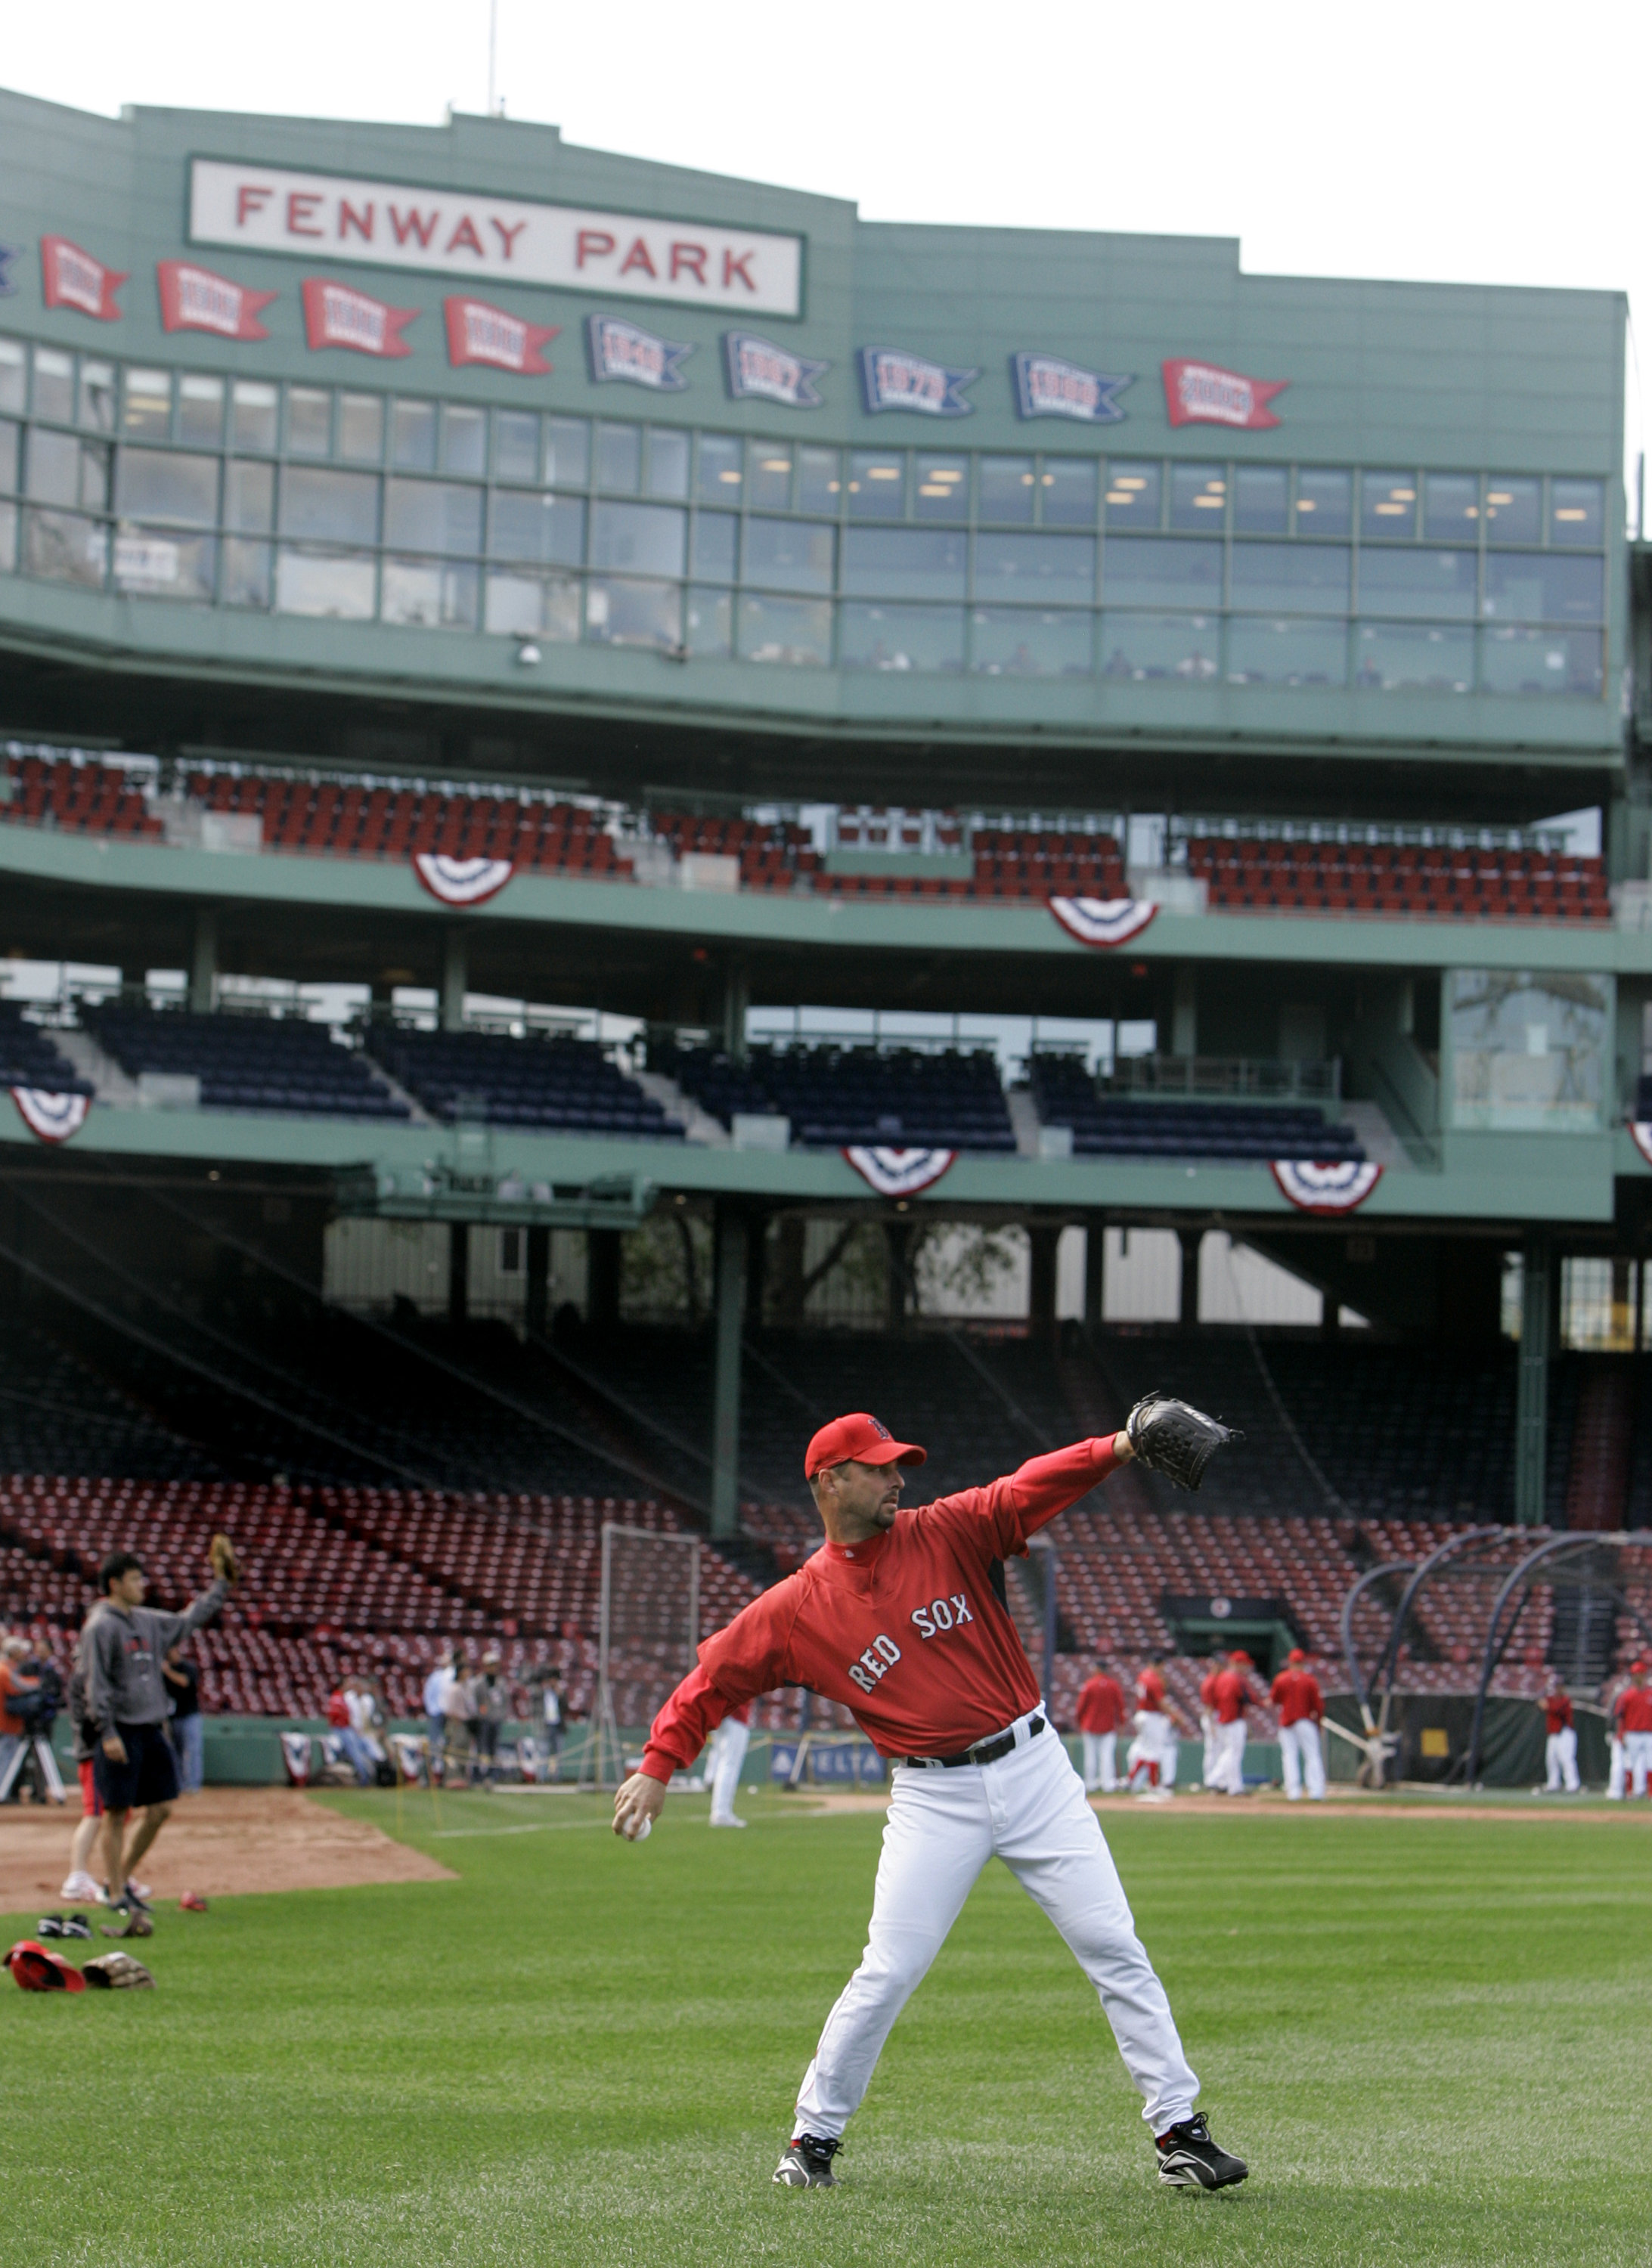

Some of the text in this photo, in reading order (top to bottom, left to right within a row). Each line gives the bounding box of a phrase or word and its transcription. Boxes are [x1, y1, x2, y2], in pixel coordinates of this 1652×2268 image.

[237, 184, 757, 293] FENWAY PARK
[848, 1593, 974, 1694] RED SOX
